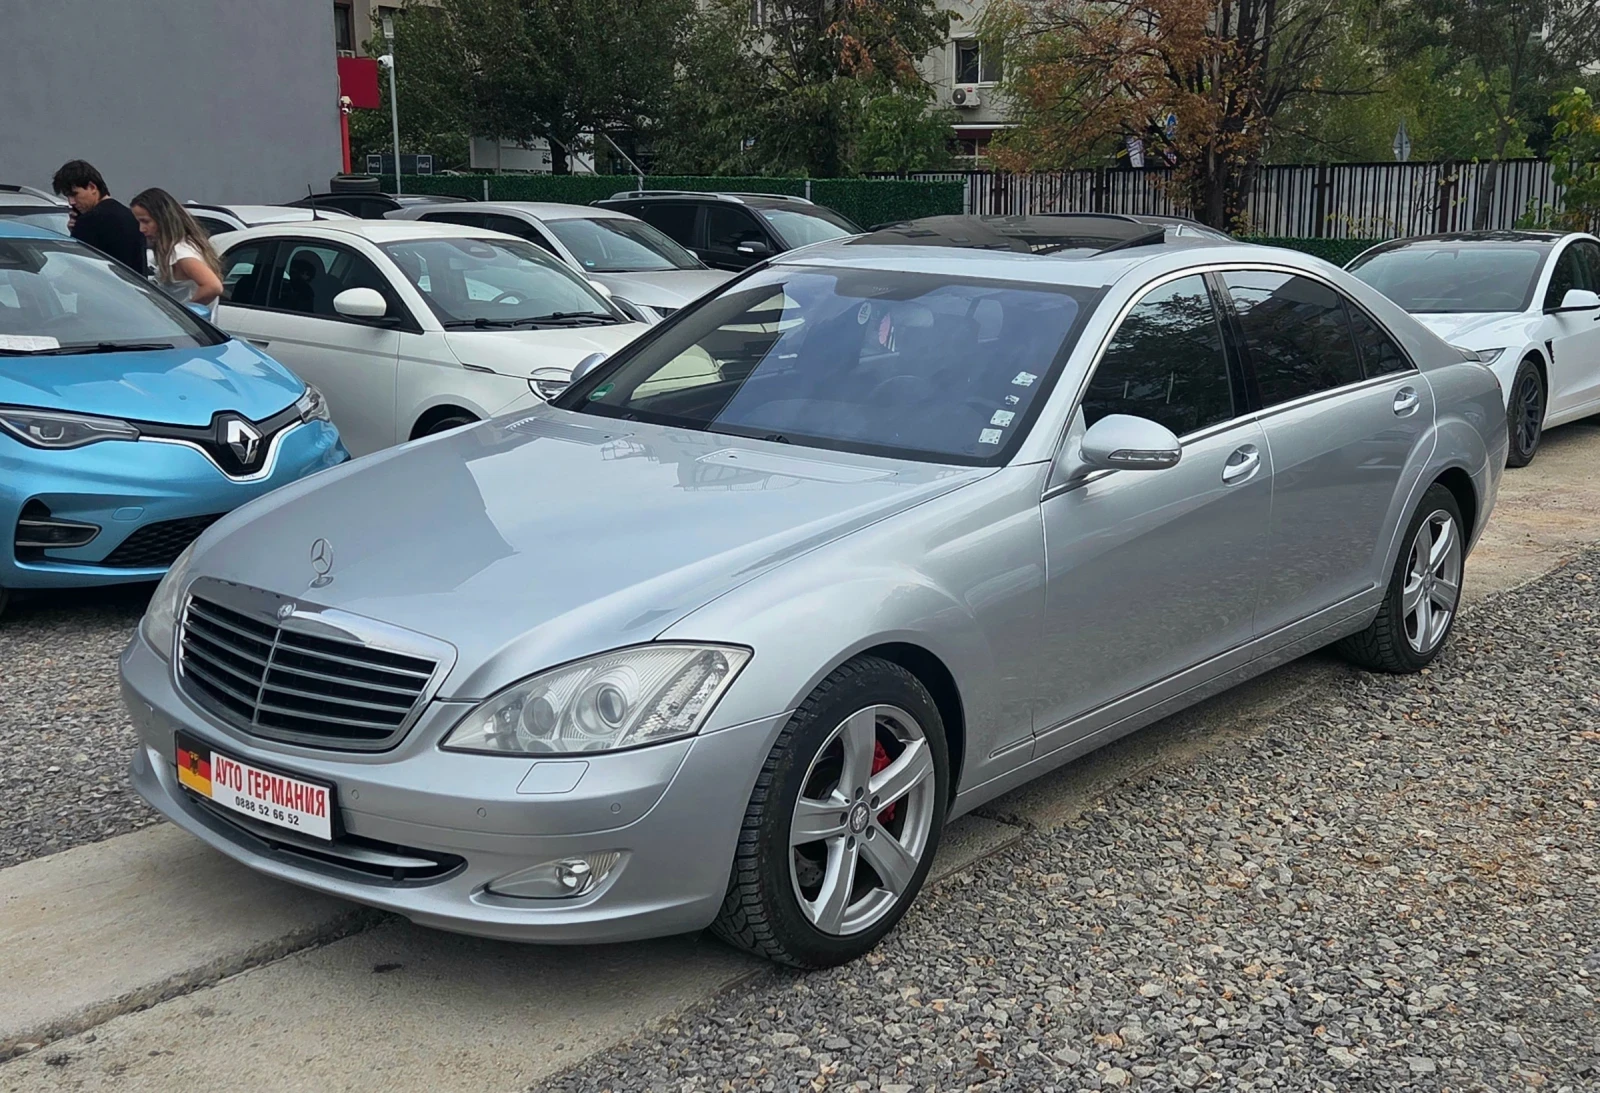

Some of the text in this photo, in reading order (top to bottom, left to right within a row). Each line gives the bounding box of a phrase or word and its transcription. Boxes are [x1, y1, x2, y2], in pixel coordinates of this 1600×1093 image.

[215, 756, 325, 818] АУТО ГЕРМАНИЯ
[235, 796, 300, 826] 0888 52 66 52
